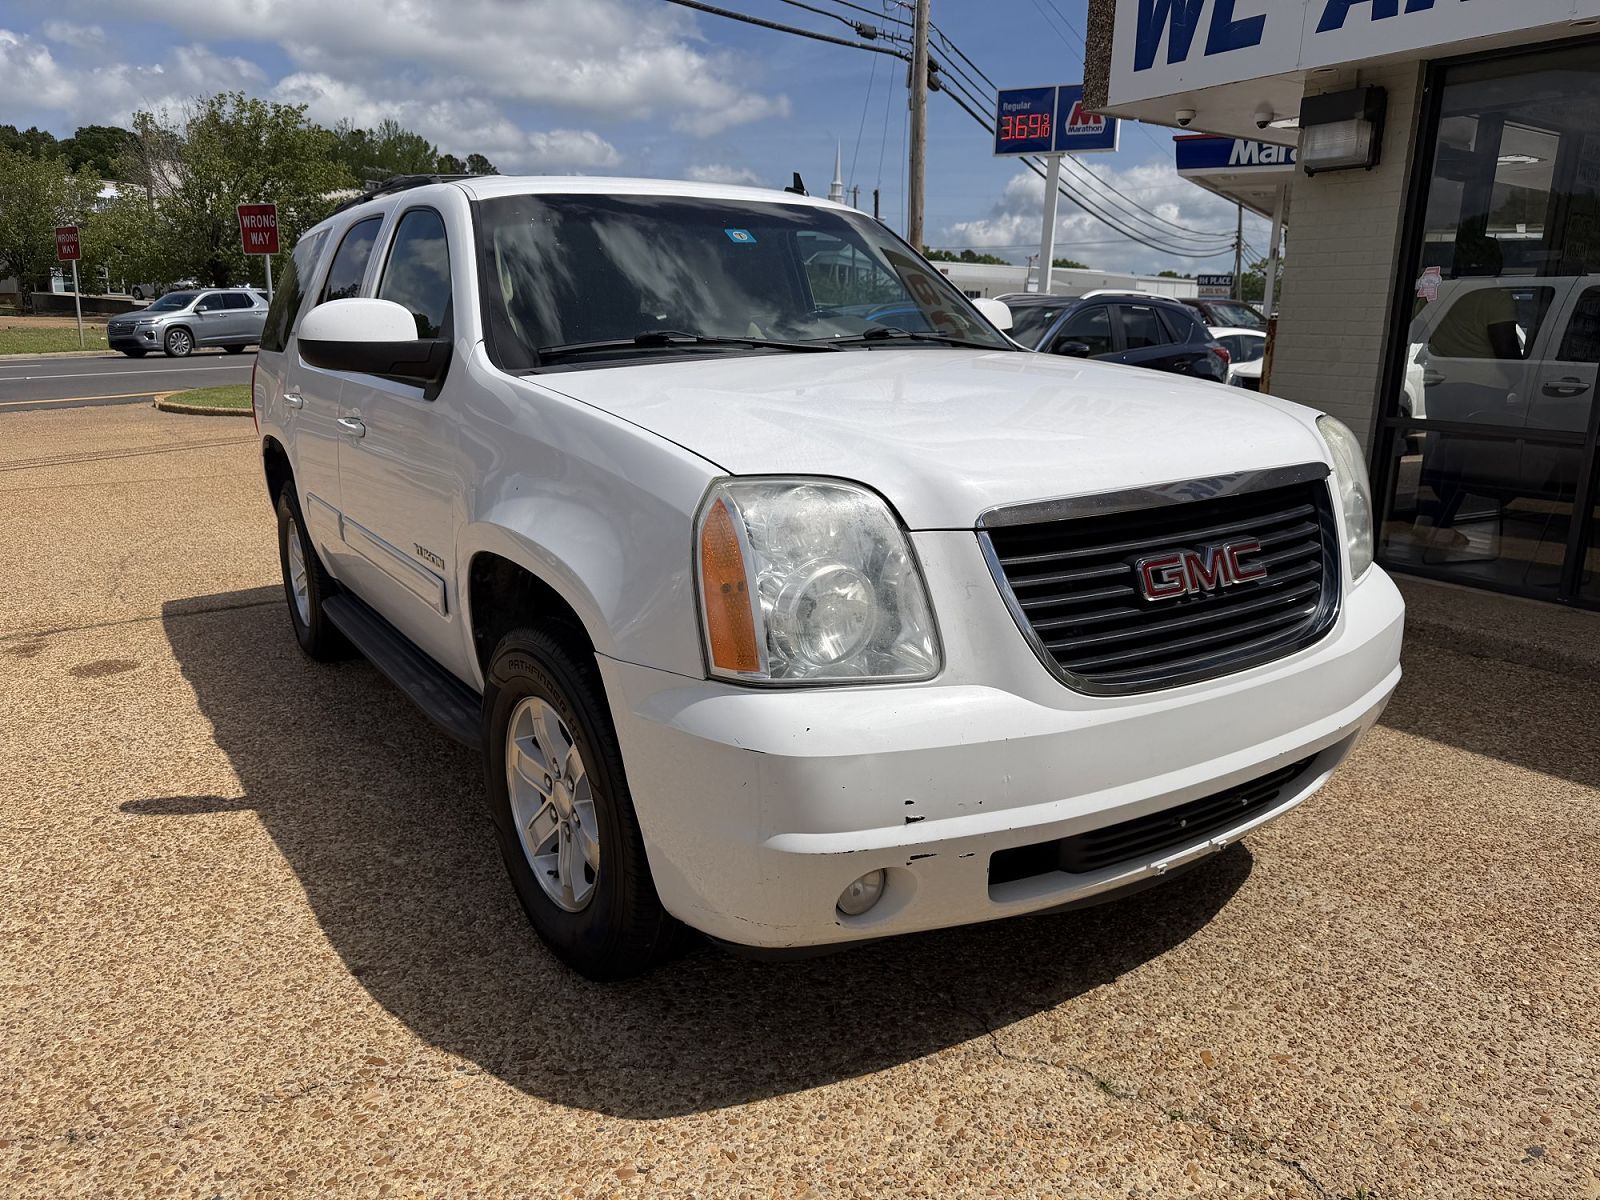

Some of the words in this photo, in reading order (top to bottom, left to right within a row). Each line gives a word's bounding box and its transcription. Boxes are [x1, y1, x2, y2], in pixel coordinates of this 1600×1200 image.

[1002, 101, 1031, 112] Regular
[1067, 124, 1103, 134] Marathon
[242, 214, 276, 228] WRONG
[57, 232, 78, 243] WRONG
[250, 231, 270, 245] WAY
[61, 244, 75, 254] WAY
[1209, 276, 1231, 285] PLACE
[1134, 538, 1268, 602] GMC
[508, 659, 568, 714] PATHFINDER
